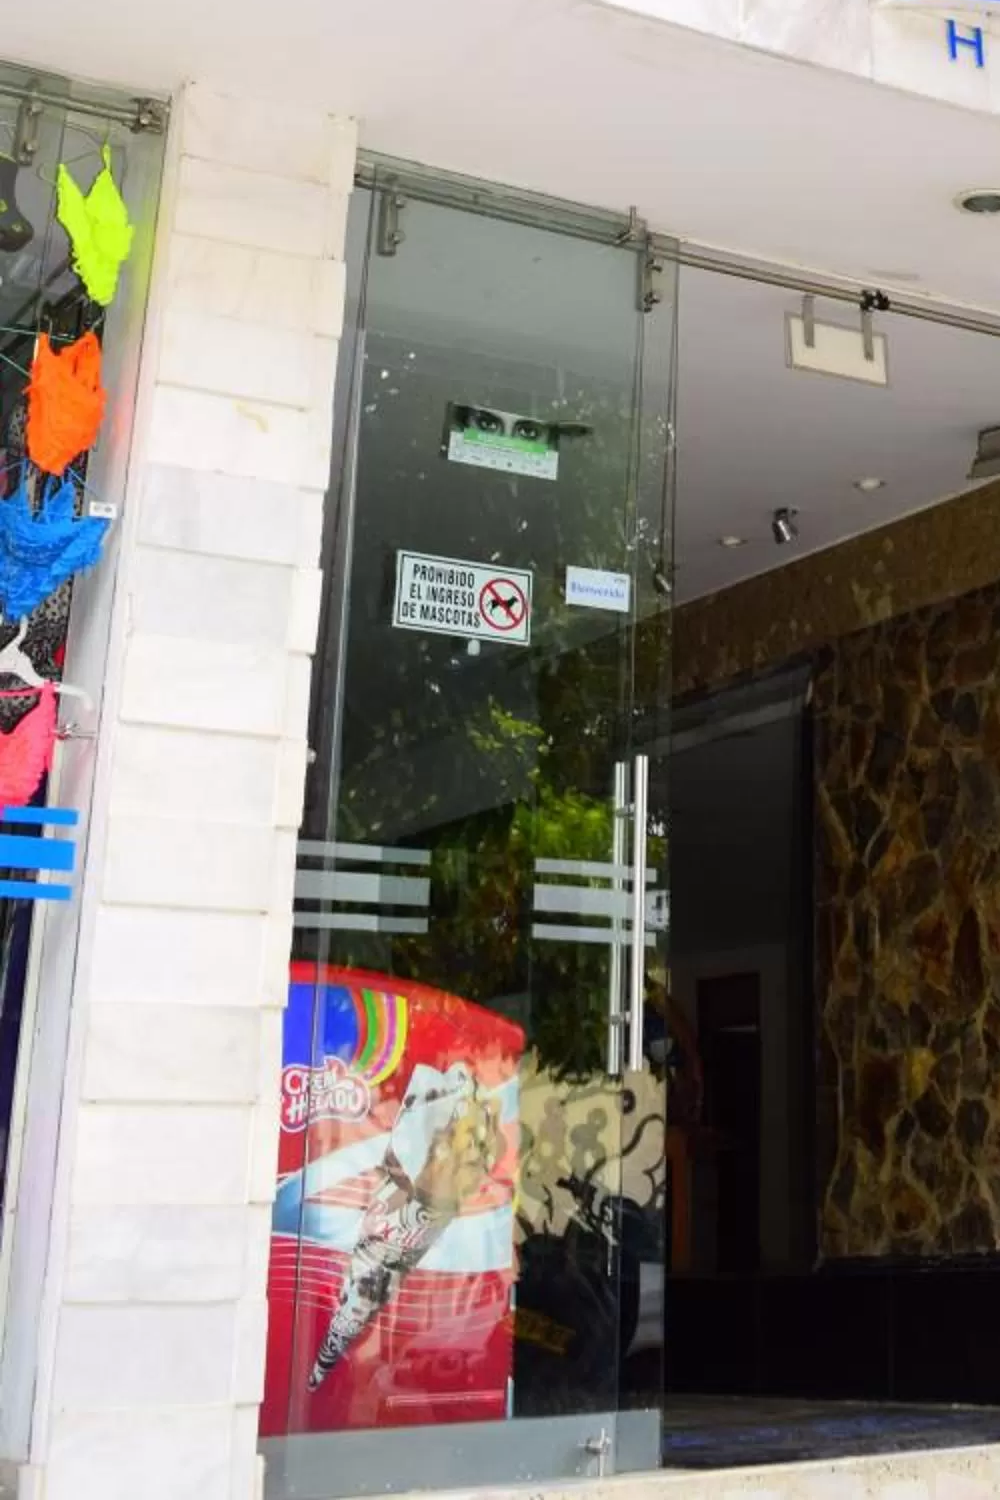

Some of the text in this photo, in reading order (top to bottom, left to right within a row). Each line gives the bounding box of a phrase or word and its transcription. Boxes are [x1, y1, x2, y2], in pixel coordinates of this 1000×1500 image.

[412, 563, 476, 589] PROHIBIDO
[408, 582, 476, 609] EL INGRESO
[401, 600, 482, 629] DE MASCOTAS
